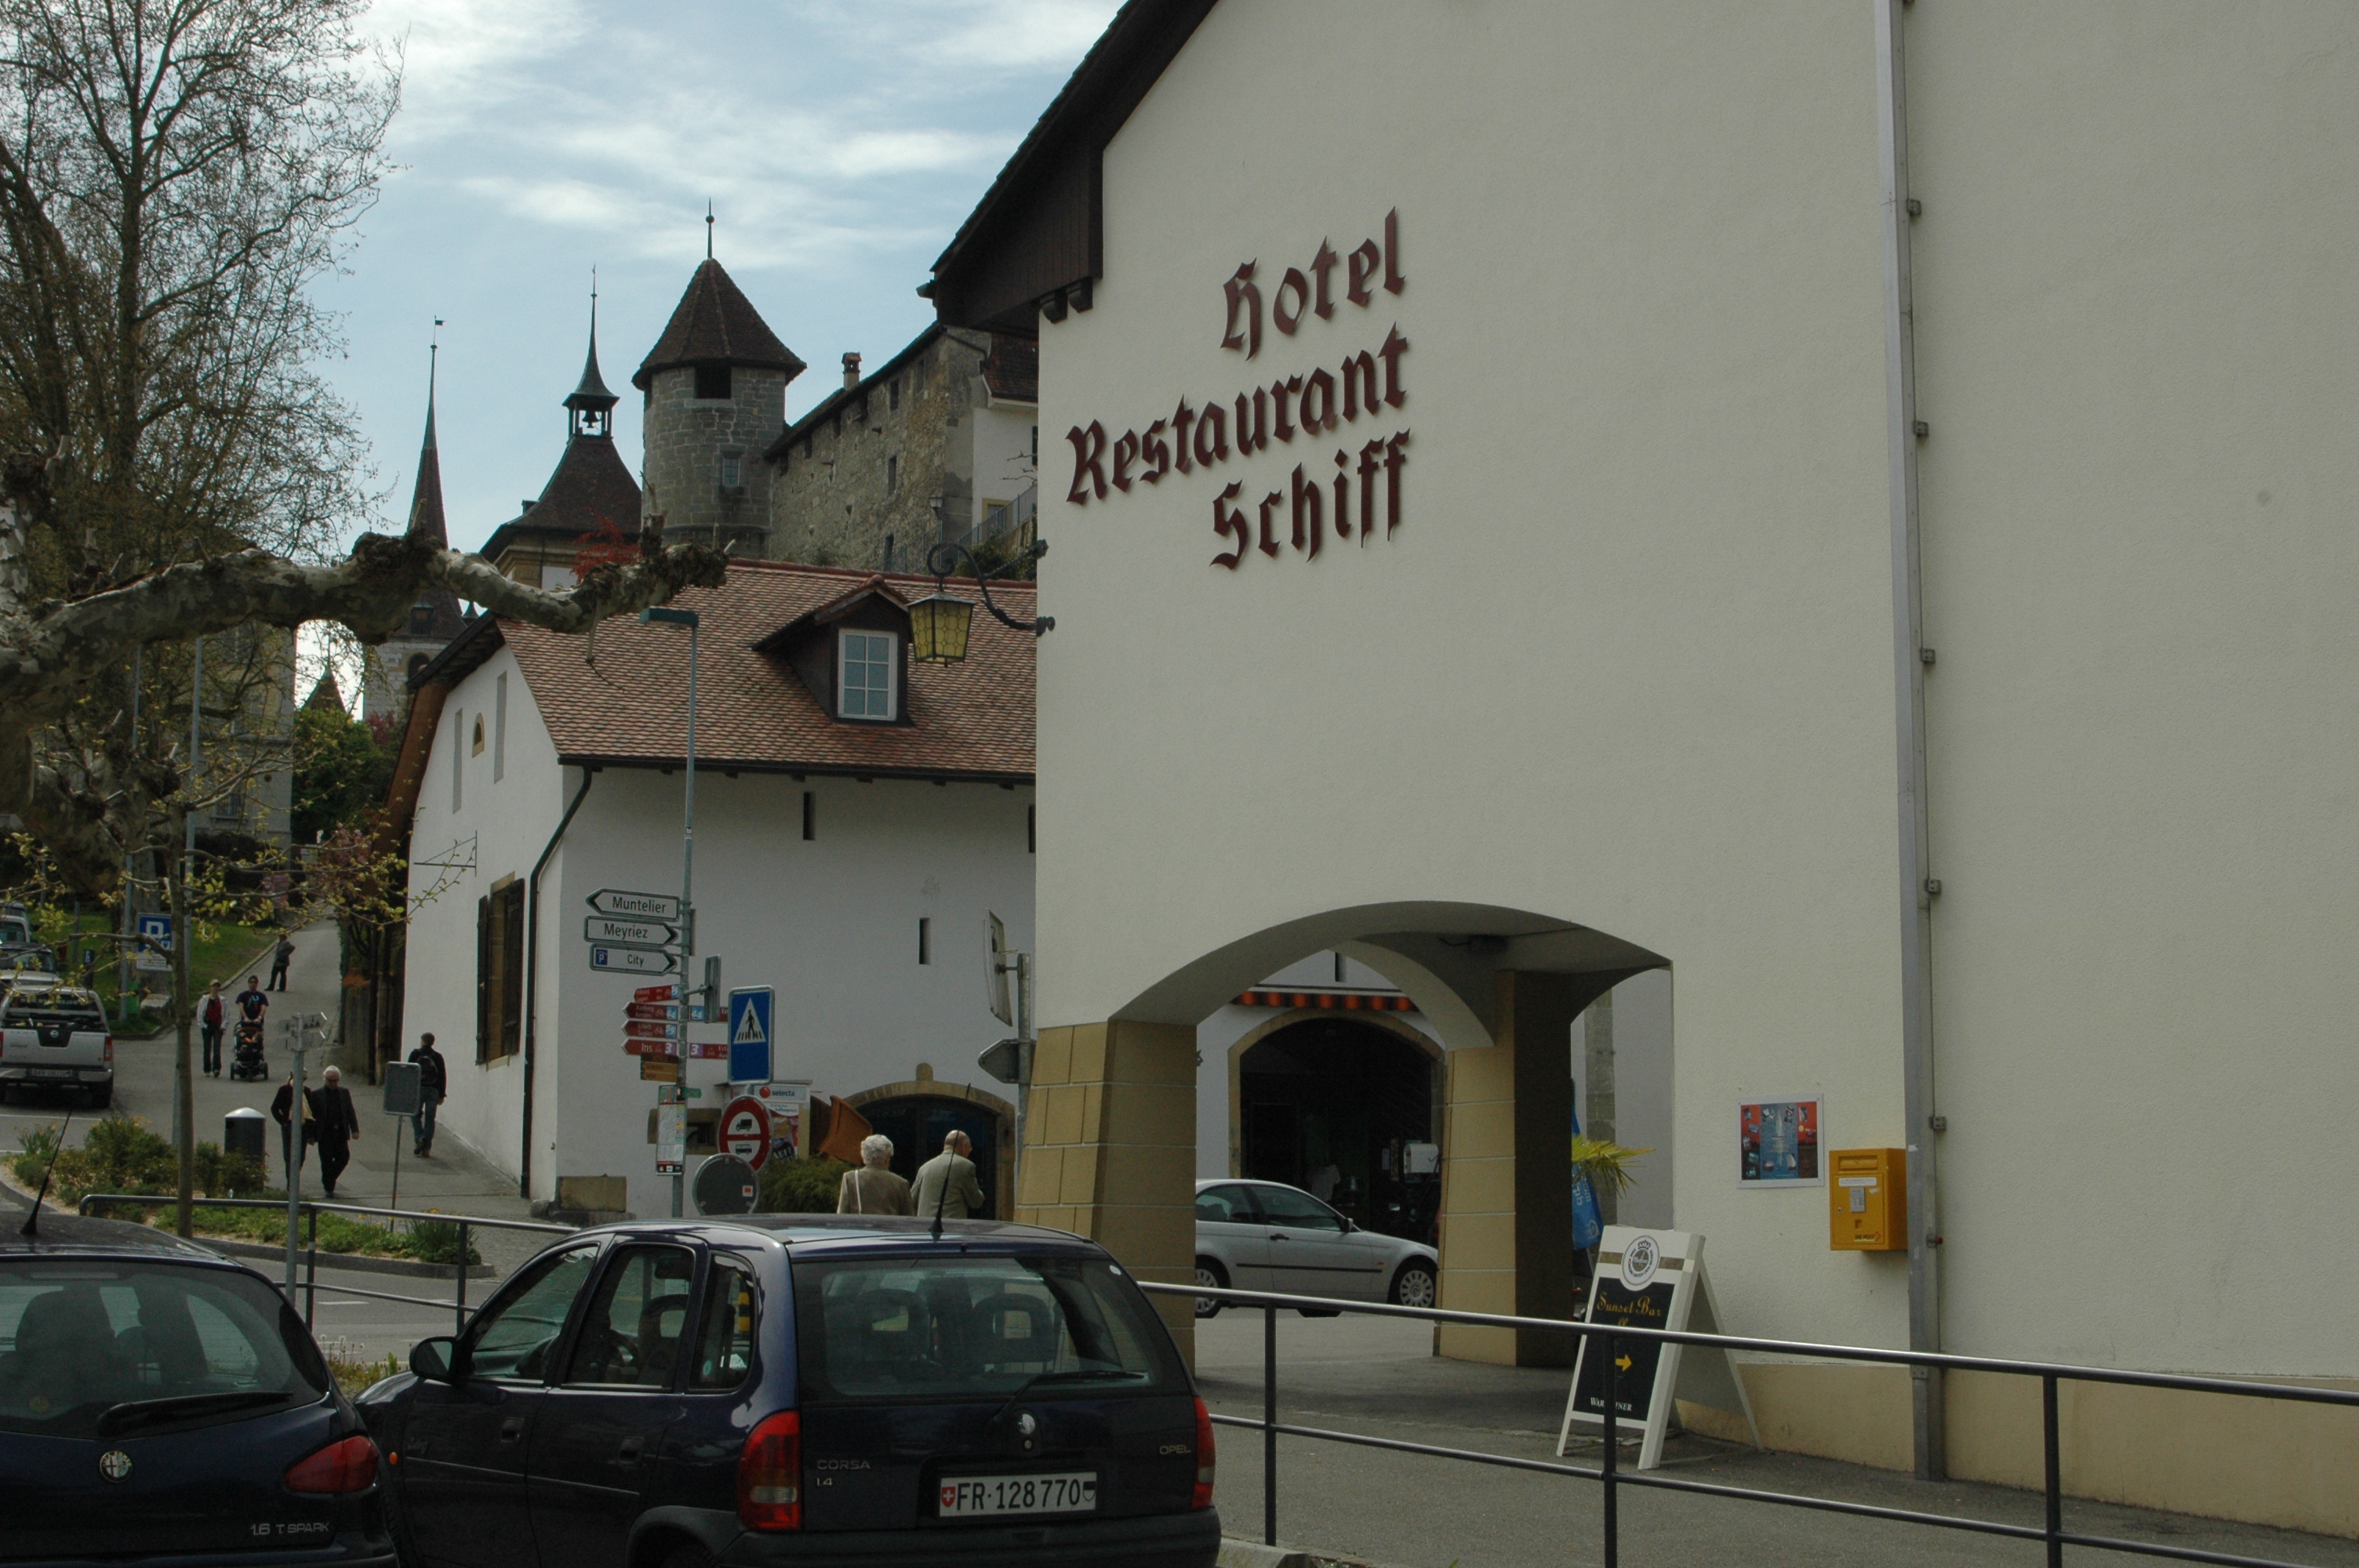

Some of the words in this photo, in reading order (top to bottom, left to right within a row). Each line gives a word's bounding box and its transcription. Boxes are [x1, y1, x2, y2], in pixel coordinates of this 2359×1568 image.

[1220, 205, 1406, 361] Hotel
[1065, 321, 1408, 506] Restaurant
[1209, 427, 1411, 571] Schiff
[612, 896, 667, 913] Muntelier
[604, 923, 648, 940] Meyriez
[627, 954, 645, 967] City
[642, 1043, 652, 1053] Ins
[1597, 1292, 1634, 1313] Sunset
[1636, 1296, 1662, 1316] Bar
[1160, 1444, 1191, 1454] OPEL
[816, 1460, 871, 1470] CORSA
